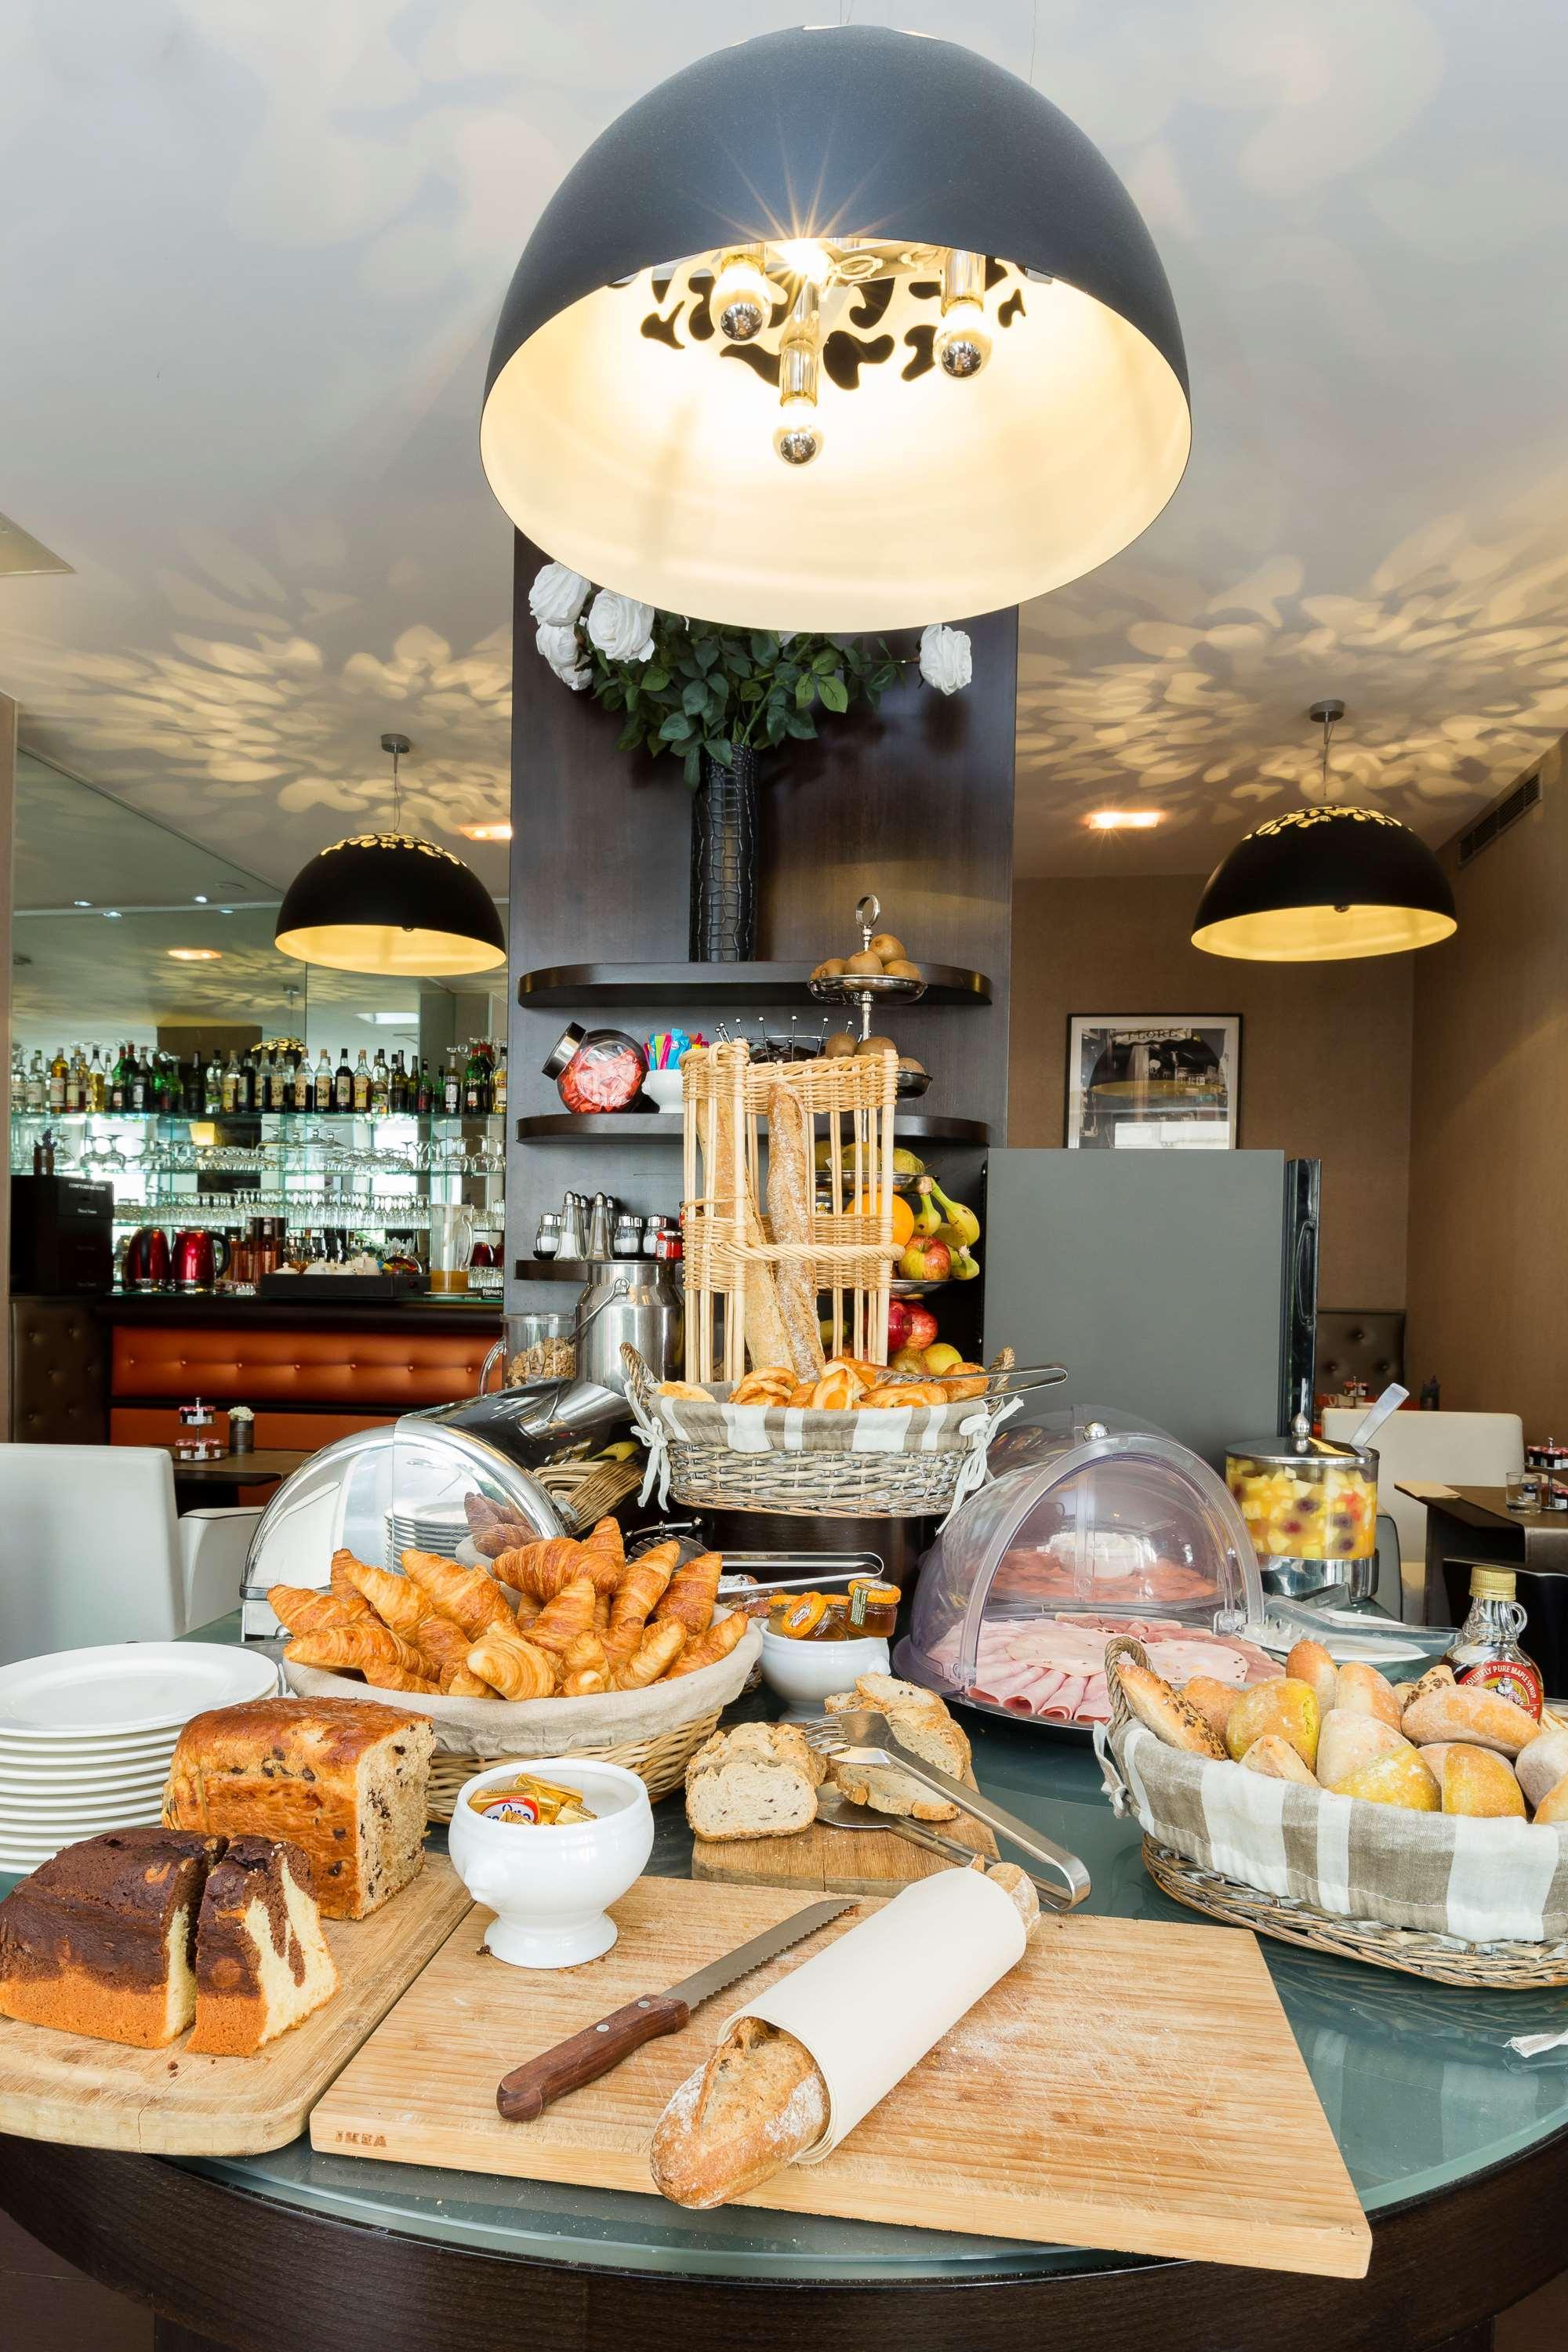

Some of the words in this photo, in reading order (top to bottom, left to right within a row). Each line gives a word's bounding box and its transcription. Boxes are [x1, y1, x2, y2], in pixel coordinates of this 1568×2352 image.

[1464, 1666, 1492, 1686] SOLUTELY
[1492, 1664, 1511, 1674] PURE
[1510, 1666, 1529, 1683] MAPLE
[1526, 1679, 1537, 1700] SYRUP
[335, 2131, 387, 2148] IKEA
